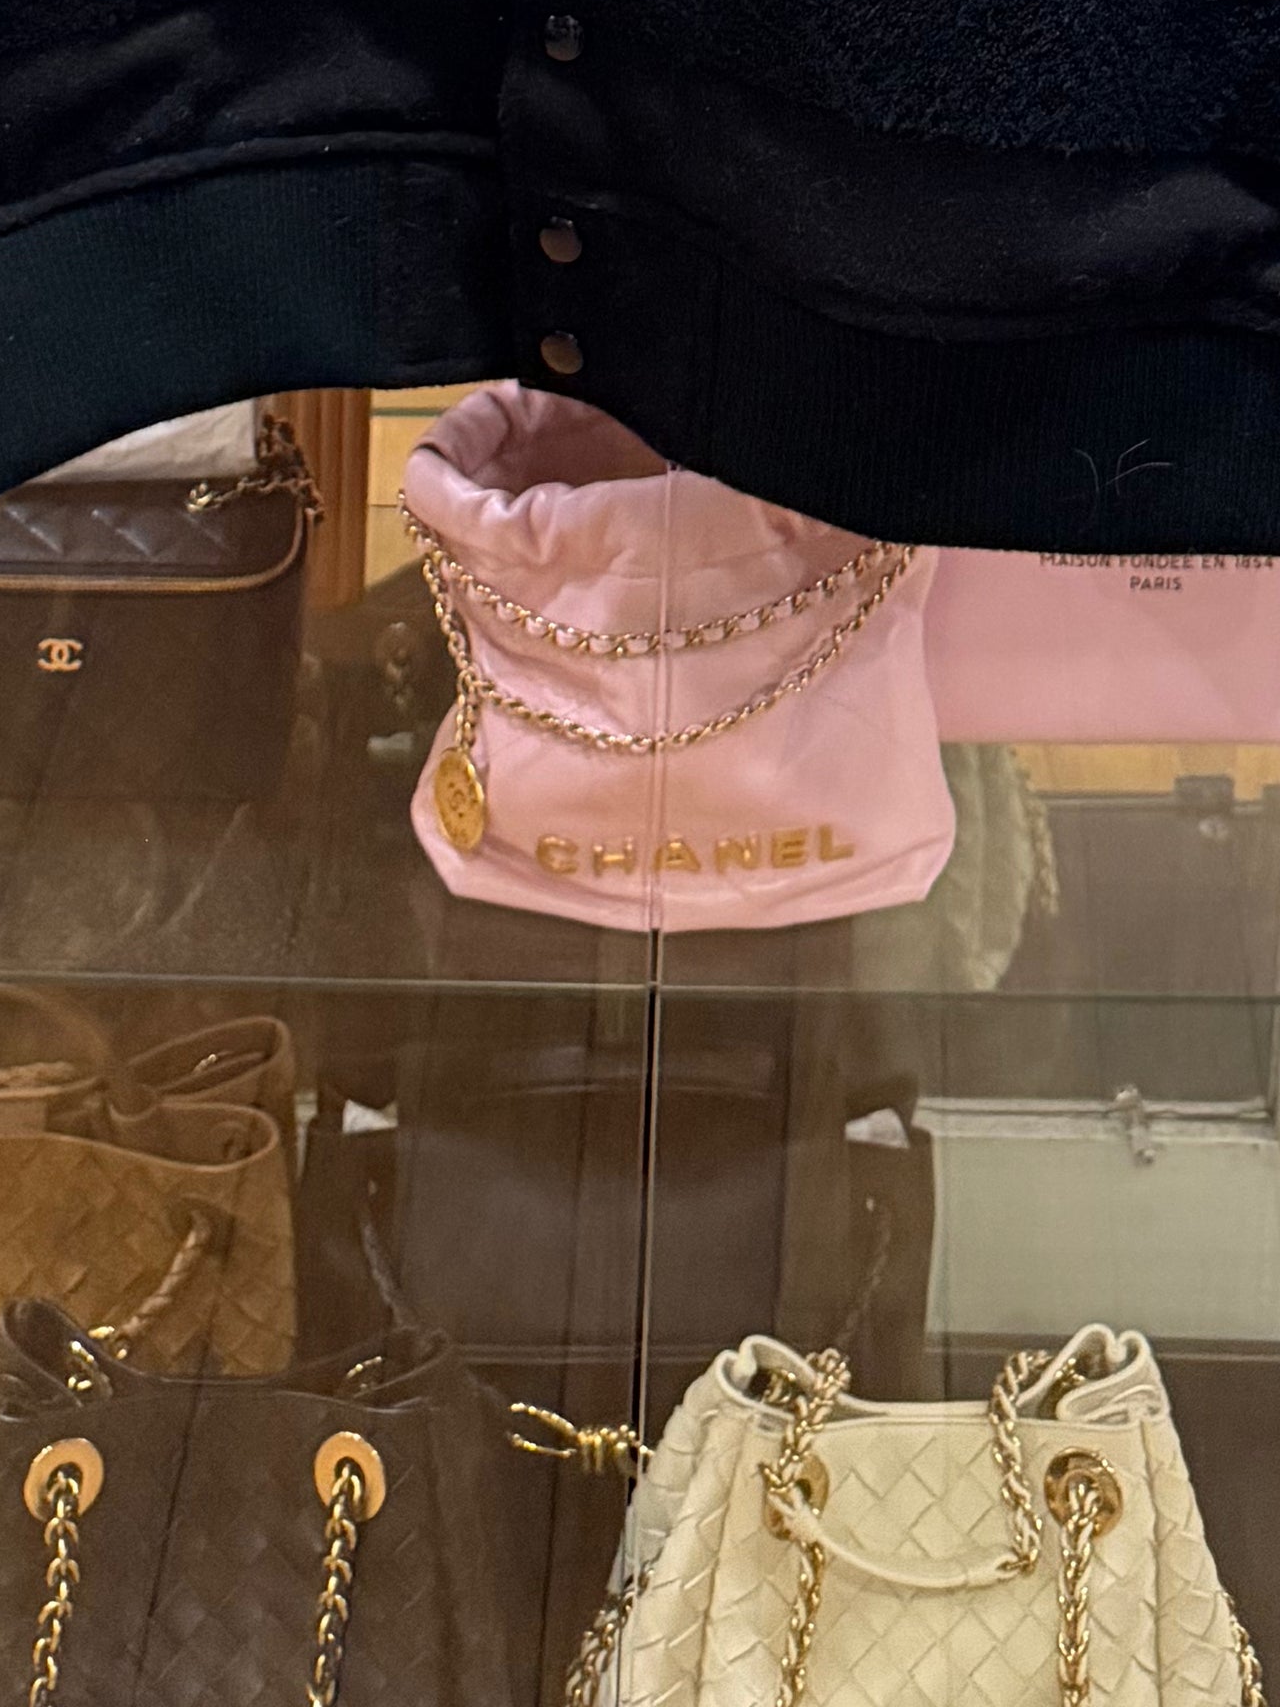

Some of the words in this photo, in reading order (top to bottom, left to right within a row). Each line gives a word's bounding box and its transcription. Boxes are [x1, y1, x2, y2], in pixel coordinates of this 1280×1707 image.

[1040, 553, 1110, 568] MAISON
[1201, 555, 1226, 570] EN
[1129, 576, 1183, 590] PARIS
[535, 824, 856, 876] CHANEL
